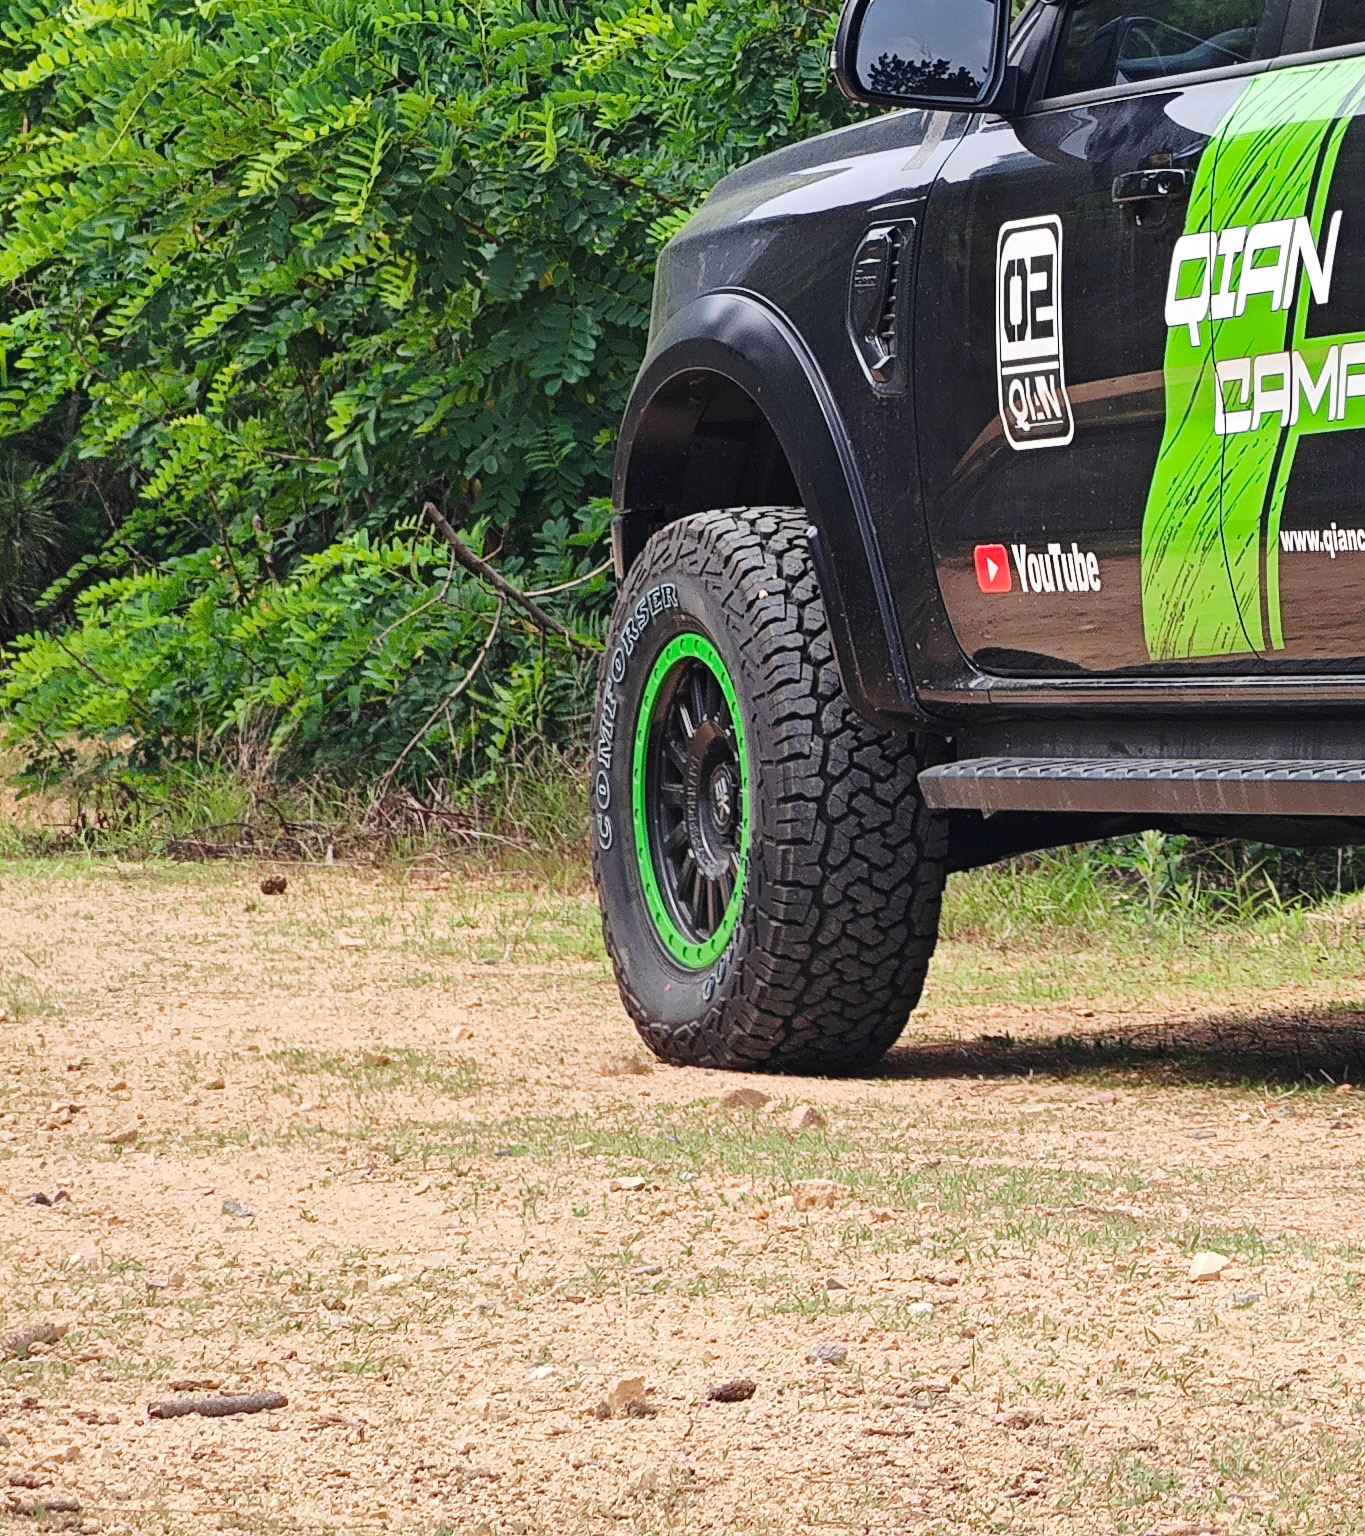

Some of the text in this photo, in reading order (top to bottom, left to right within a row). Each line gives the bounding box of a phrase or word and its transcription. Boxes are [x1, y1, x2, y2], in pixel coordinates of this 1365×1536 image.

[1165, 210, 1343, 346] QIAN
[1011, 543, 1101, 592] YouTube
[596, 583, 680, 851] COMFORSER
